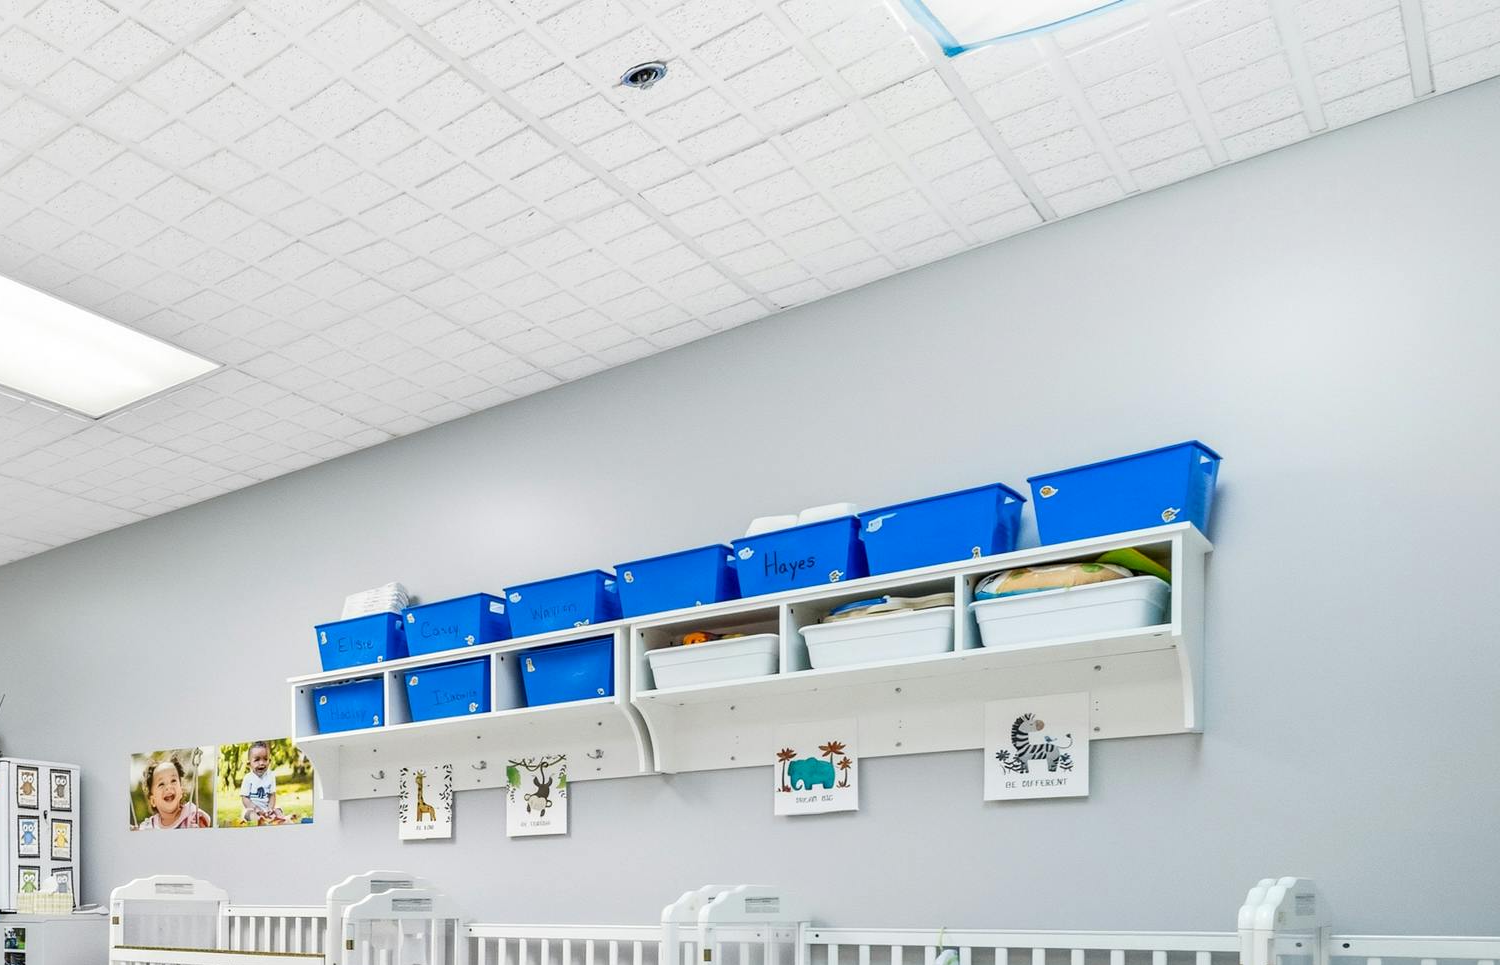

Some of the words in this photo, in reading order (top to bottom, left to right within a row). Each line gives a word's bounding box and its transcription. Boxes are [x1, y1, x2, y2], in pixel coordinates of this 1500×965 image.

[764, 552, 816, 581] Hayes
[338, 637, 374, 653] Elsie
[1022, 778, 1068, 788] DIFFERENT
